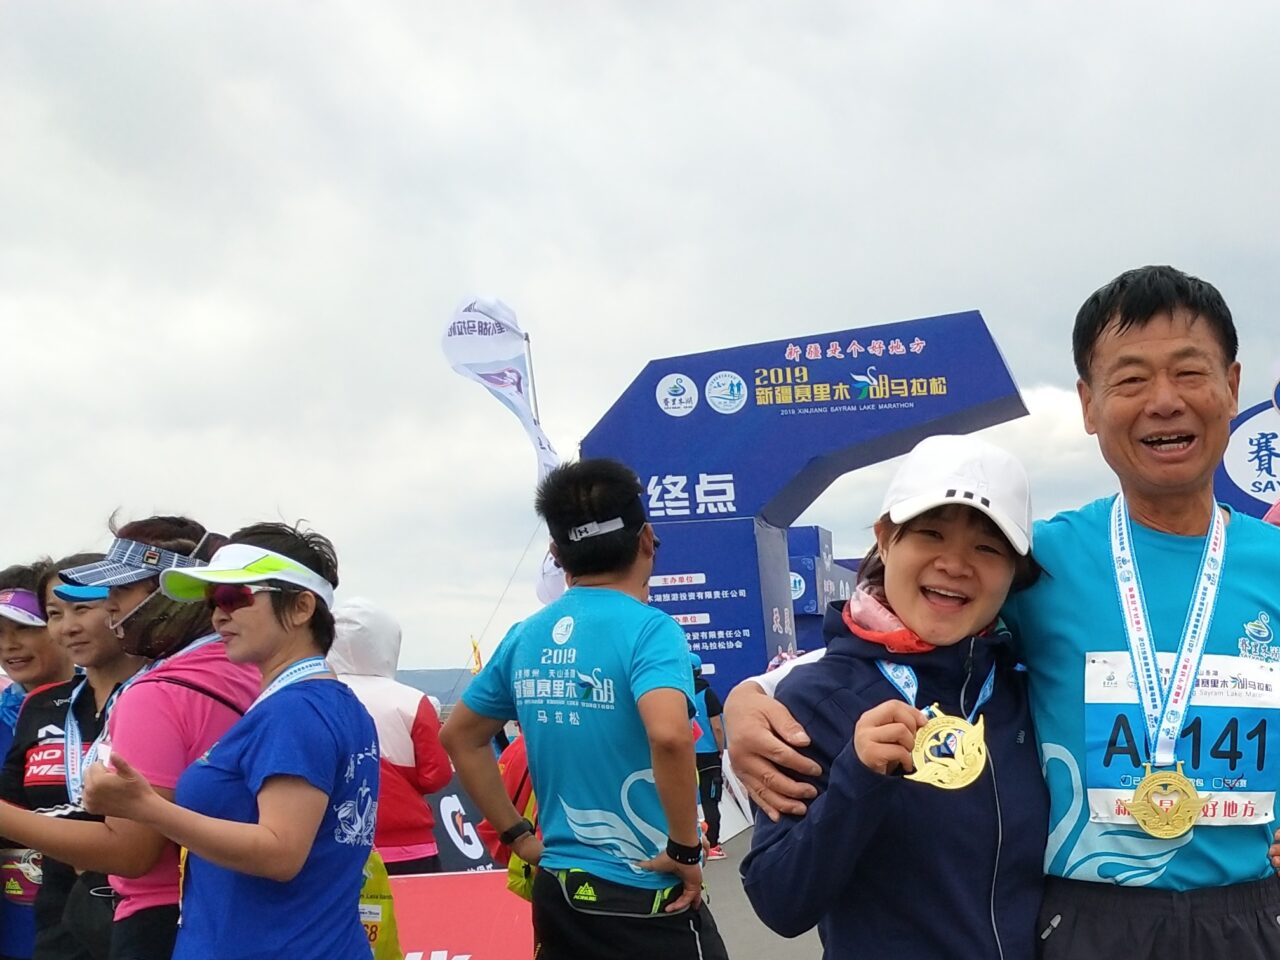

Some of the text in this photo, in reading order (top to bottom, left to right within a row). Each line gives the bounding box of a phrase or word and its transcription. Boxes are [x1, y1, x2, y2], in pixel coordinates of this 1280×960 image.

[785, 337, 926, 361] 新疆是个好地方
[755, 366, 808, 385] 2019
[878, 402, 914, 411] MARATHON
[648, 473, 737, 517] 终点
[541, 648, 576, 664] 2019
[537, 710, 580, 725] 马拉松
[1103, 714, 1267, 771] A141
